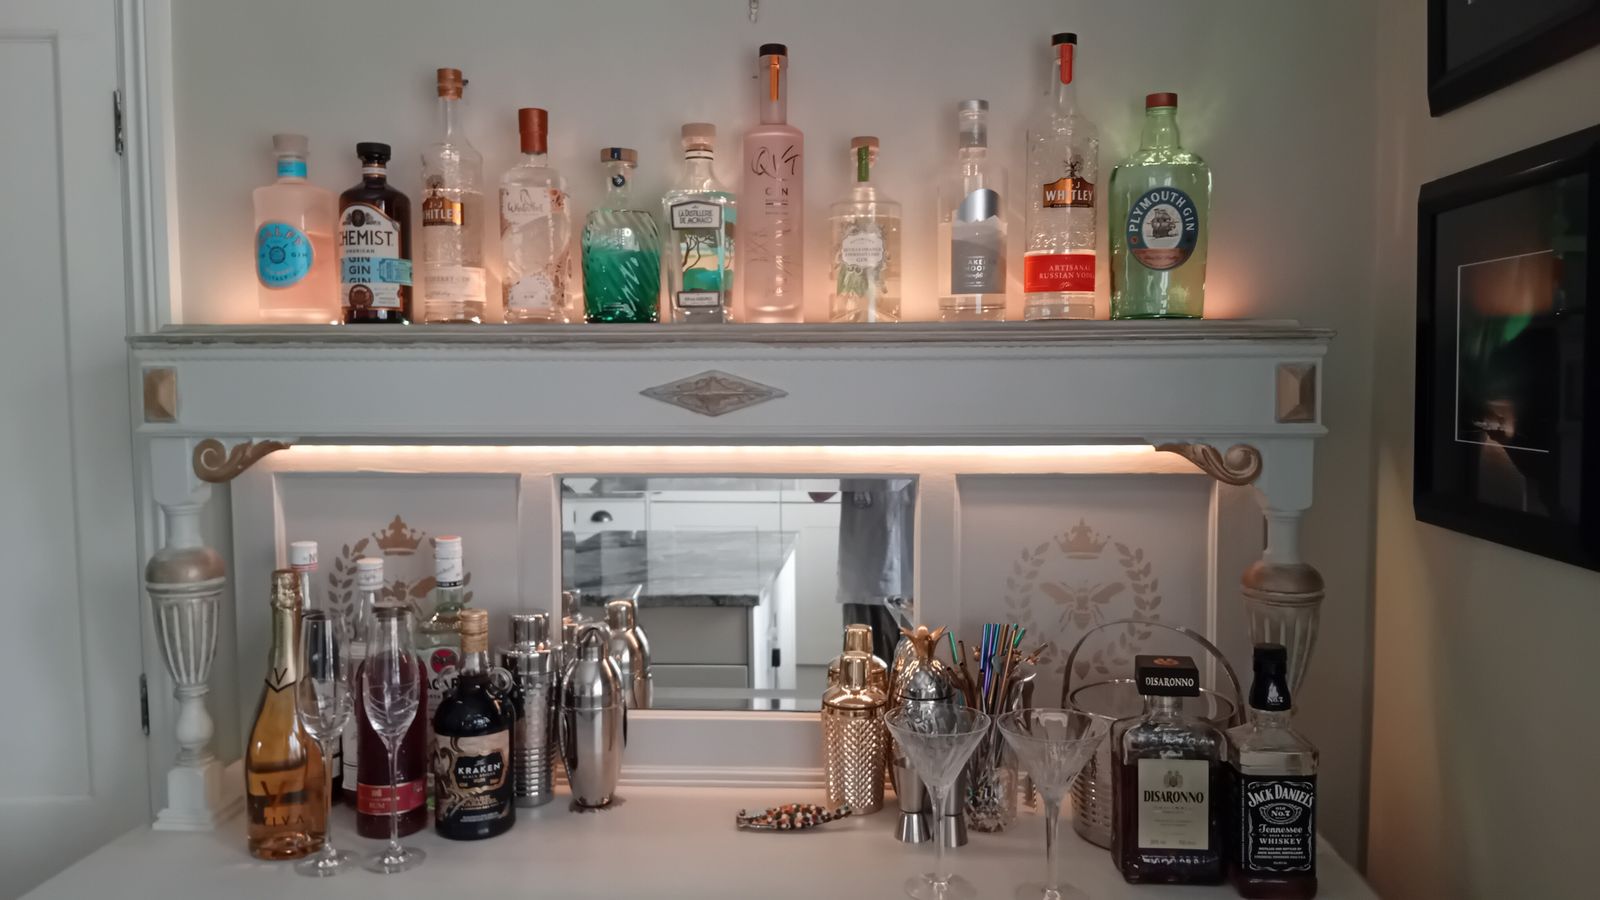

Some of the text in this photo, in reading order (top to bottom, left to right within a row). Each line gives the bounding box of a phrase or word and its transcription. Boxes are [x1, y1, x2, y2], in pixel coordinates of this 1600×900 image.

[765, 187, 788, 196] GN
[1046, 189, 1093, 201] WHTLEY
[1129, 190, 1195, 232] PLYMOUTH GIN
[339, 229, 393, 246] CHEMIST
[348, 265, 371, 274] GIN
[427, 678, 459, 691] ACAR
[1145, 676, 1195, 688] DISARONNO
[457, 762, 501, 775] KRAKEN
[1143, 790, 1204, 804] DISARONNO
[1247, 784, 1315, 808] JACK DANIEL'S
[1258, 823, 1303, 834] Tennessee
